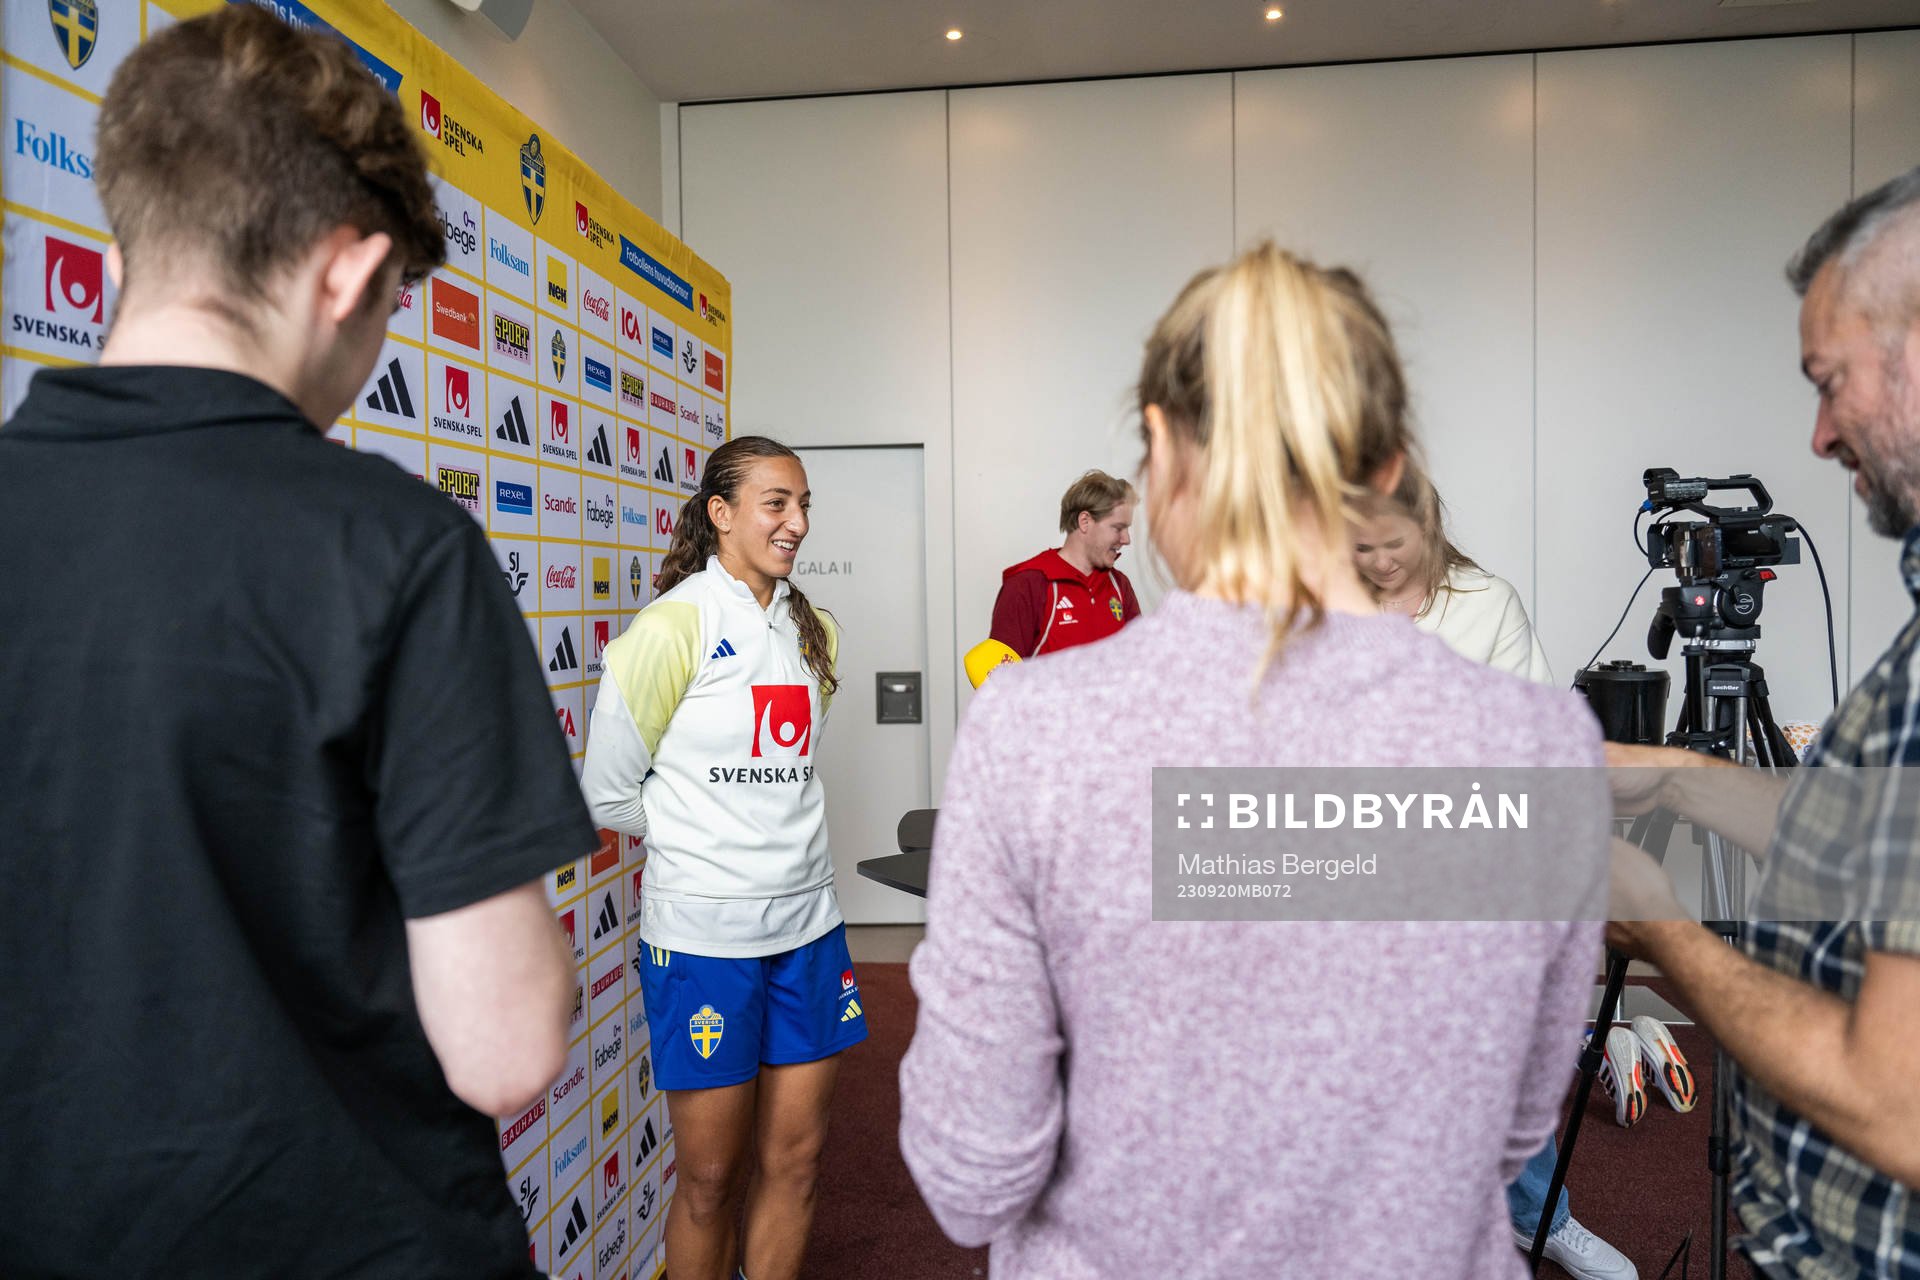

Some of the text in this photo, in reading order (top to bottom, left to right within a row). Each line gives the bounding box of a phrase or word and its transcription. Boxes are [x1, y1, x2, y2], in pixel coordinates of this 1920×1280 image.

[443, 114, 483, 154] SVENSKA
[443, 131, 465, 157] SPEL
[589, 217, 615, 246] SVENSKA
[589, 231, 604, 250] SPEL
[490, 238, 529, 276] Folksam
[626, 247, 654, 276] Fotbollens
[436, 302, 467, 322] Swedbank
[621, 306, 642, 345] ICA
[12, 314, 92, 348] SVENSKA
[494, 315, 529, 351] SPORT
[497, 343, 529, 361] BLADET
[621, 371, 643, 400] SPORT
[651, 393, 676, 414] BAUHAUS
[433, 416, 482, 438] SVENSKA SPEL
[542, 443, 578, 461] SVENSKA SPEL
[438, 468, 479, 500] SPORT
[620, 464, 647, 479] SVENSKA SPEL
[545, 494, 577, 514] Scandic
[586, 500, 614, 528] Fabege
[622, 507, 647, 526] Folksam
[656, 508, 673, 535] ICA
[509, 552, 519, 573] SJ
[797, 561, 852, 575] GALA II
[709, 766, 799, 784] SVENSKA
[591, 964, 624, 999] BAUHAUS
[595, 1037, 622, 1071] Fabege
[553, 1065, 585, 1105] Scandic
[502, 1099, 546, 1150] BAUHAUS
[555, 1136, 587, 1179] Folksam
[520, 1176, 530, 1202] SJ
[598, 1230, 625, 1273] Fabege
